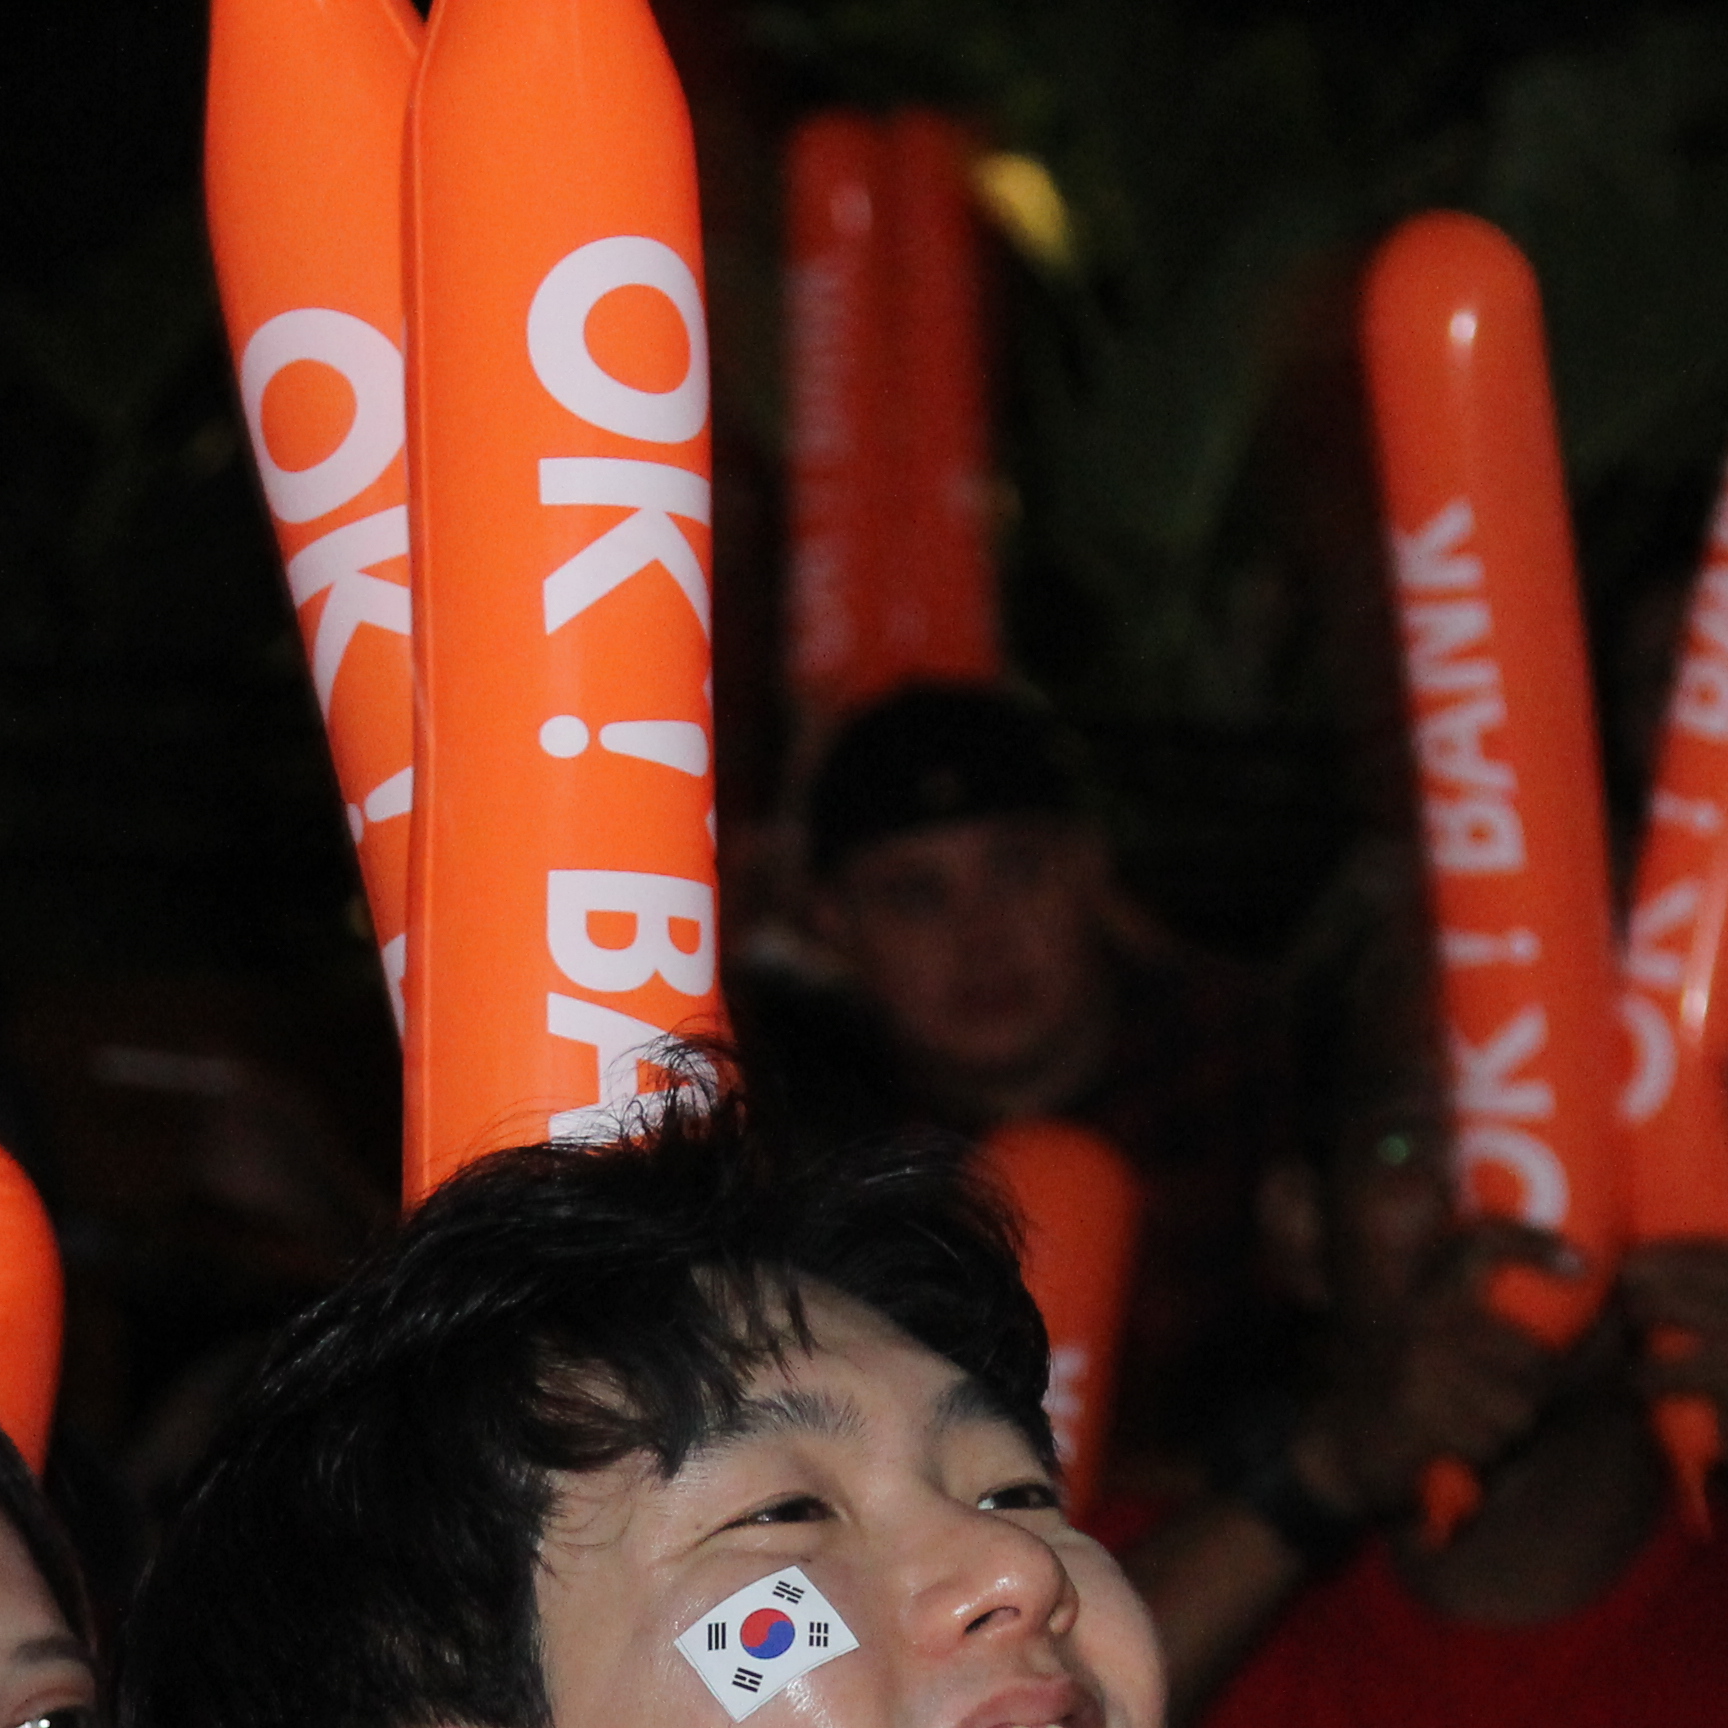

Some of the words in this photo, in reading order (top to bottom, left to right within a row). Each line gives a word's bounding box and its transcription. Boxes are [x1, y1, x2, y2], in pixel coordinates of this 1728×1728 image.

[239, 306, 413, 738] OK
[527, 235, 713, 645] OK
[538, 712, 710, 778] !
[1391, 498, 1528, 874] BANK
[545, 868, 718, 1146] BA
